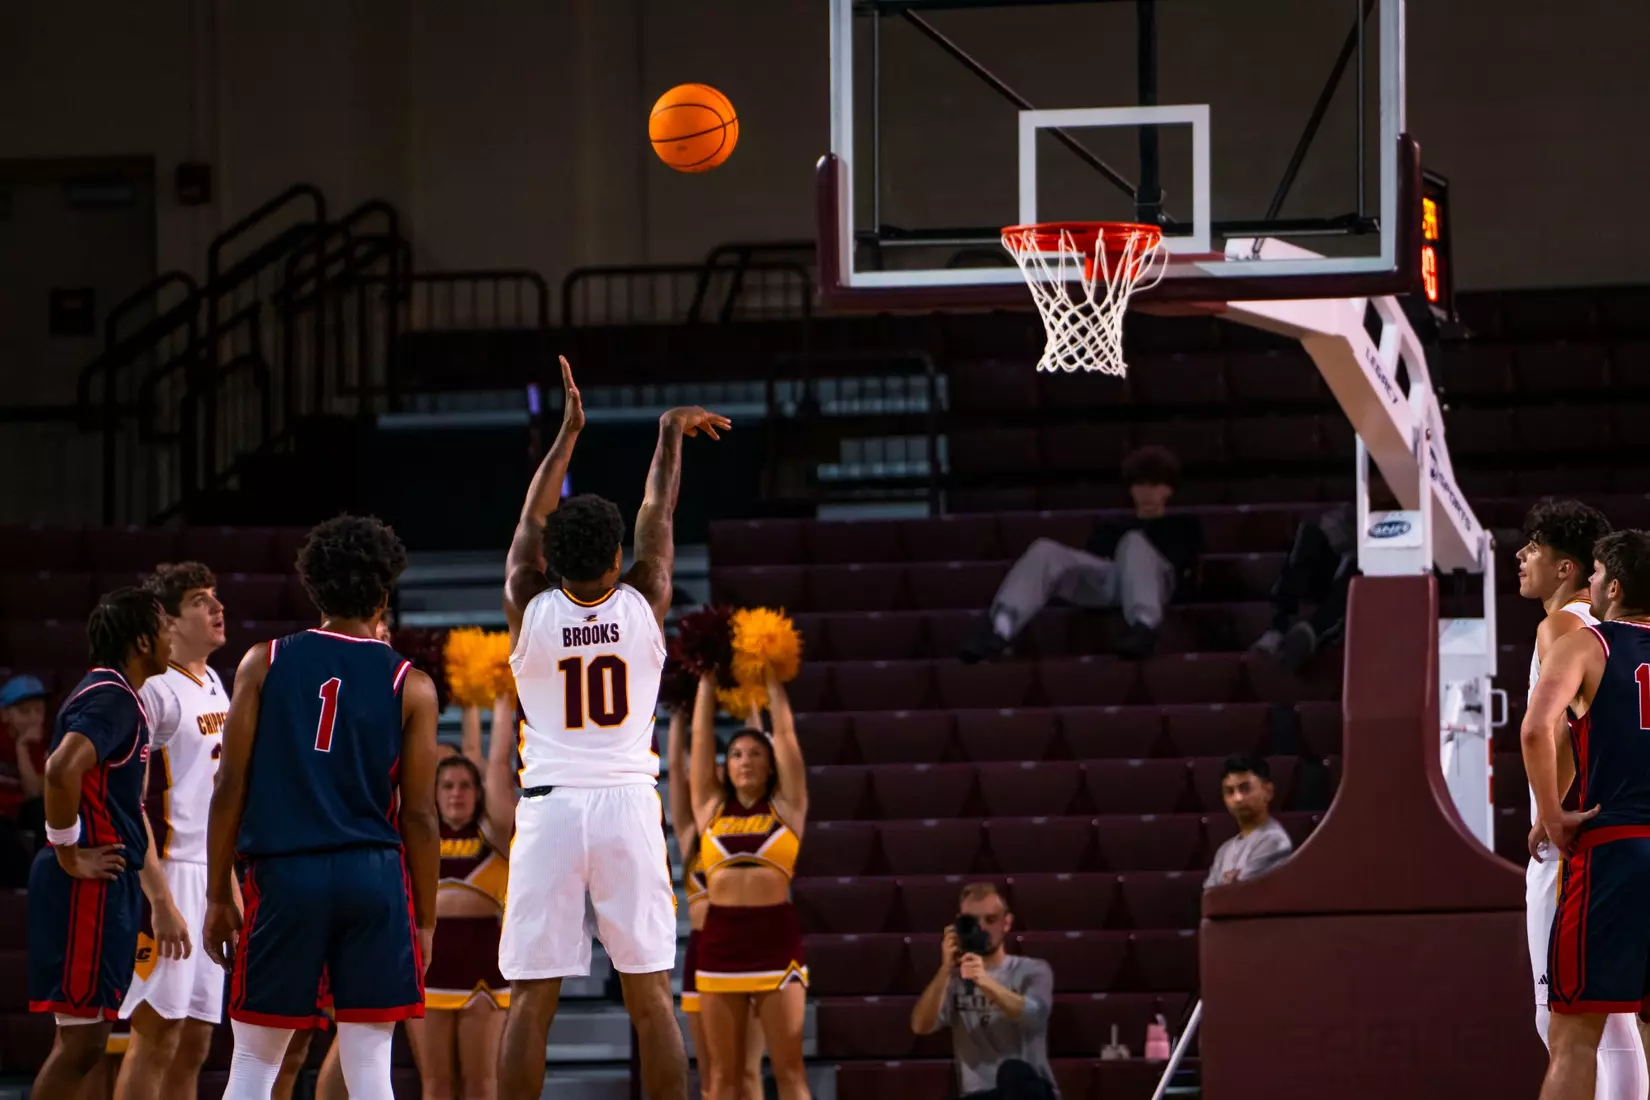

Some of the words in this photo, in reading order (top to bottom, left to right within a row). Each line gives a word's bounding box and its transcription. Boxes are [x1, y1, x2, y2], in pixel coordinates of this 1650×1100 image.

[562, 623, 620, 648] BROOKS
[314, 676, 342, 752] 1
[557, 654, 630, 730] 10
[1634, 662, 1650, 730] 1
[440, 838, 481, 857] MU
